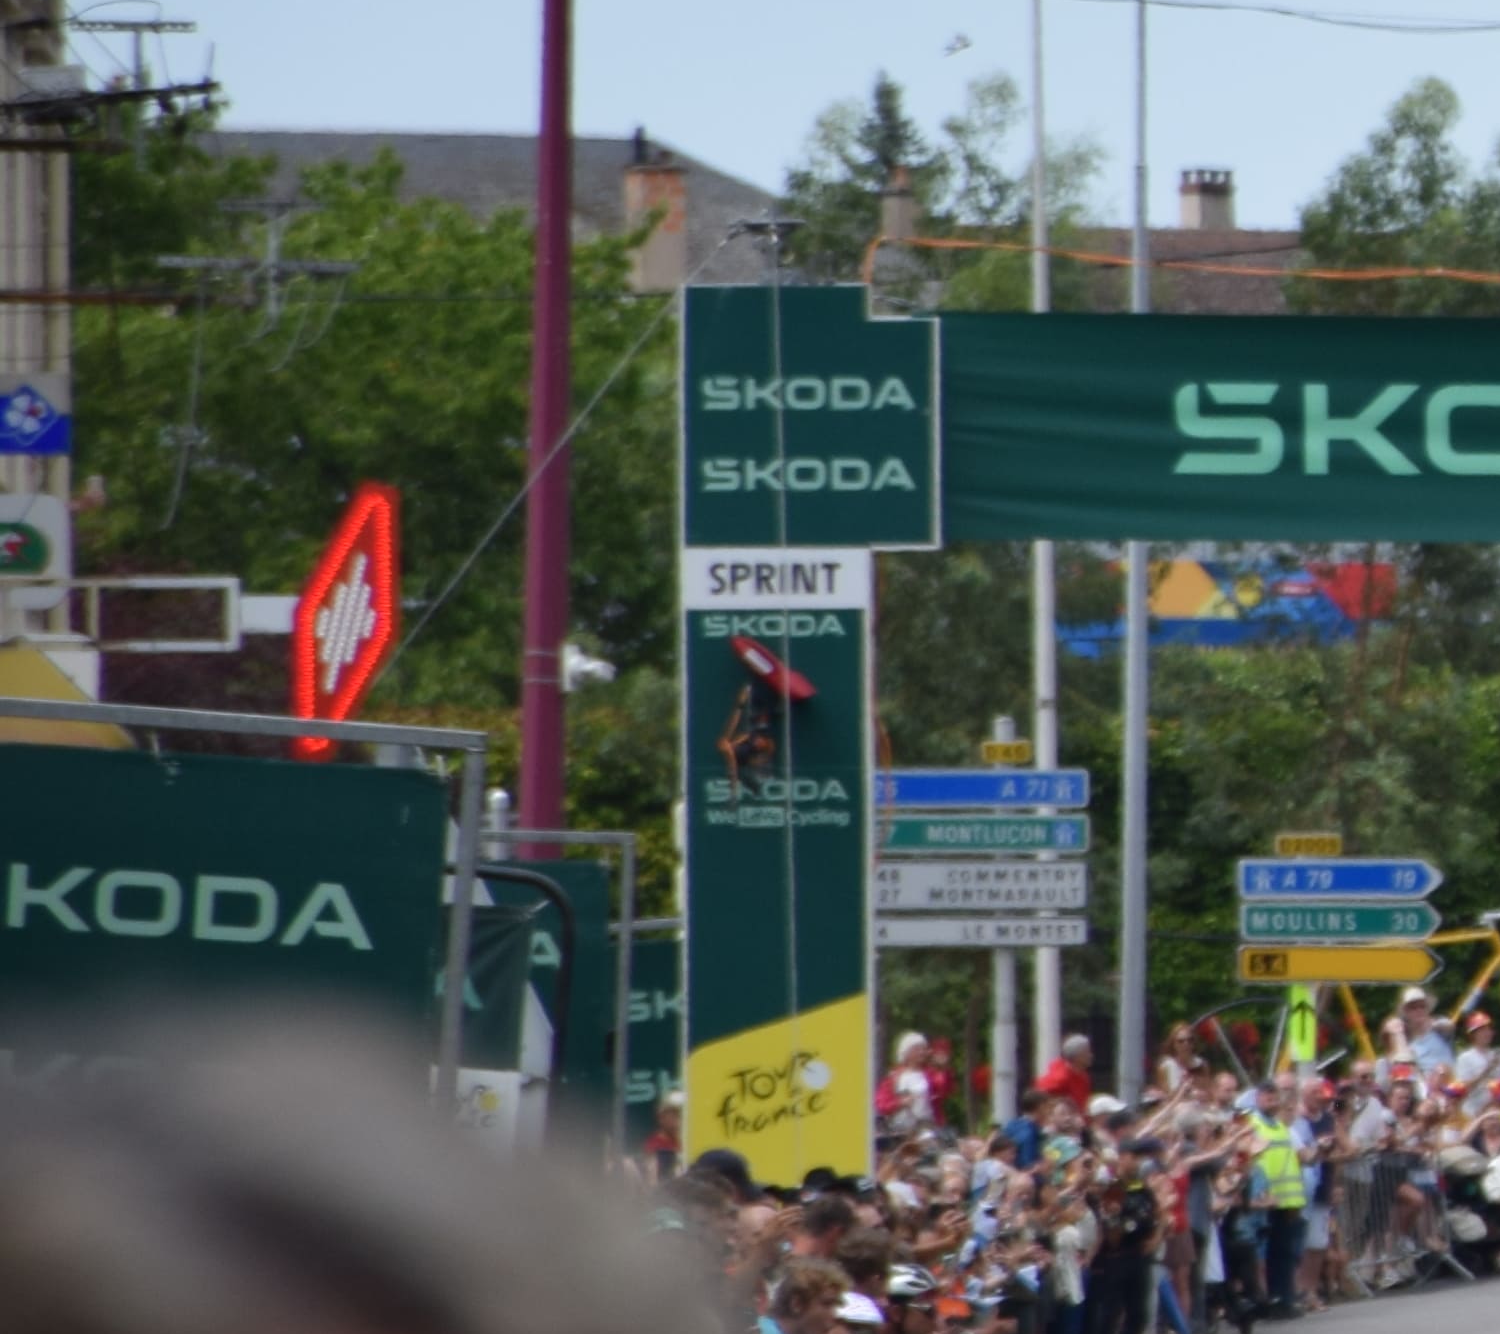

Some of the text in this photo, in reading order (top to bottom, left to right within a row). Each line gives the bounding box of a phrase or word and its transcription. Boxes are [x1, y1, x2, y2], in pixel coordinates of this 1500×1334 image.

[709, 562, 842, 596] SPRINT
[1000, 778, 1017, 798] A
[946, 870, 1080, 884] COMMENTRY
[1282, 870, 1297, 889] A
[1306, 869, 1334, 889] 79
[929, 888, 1081, 903] MONTMARAULT
[7, 864, 374, 951] KODA
[1251, 913, 1358, 932] MOULINS
[963, 926, 985, 940] LE
[996, 926, 1081, 940] MONTET
